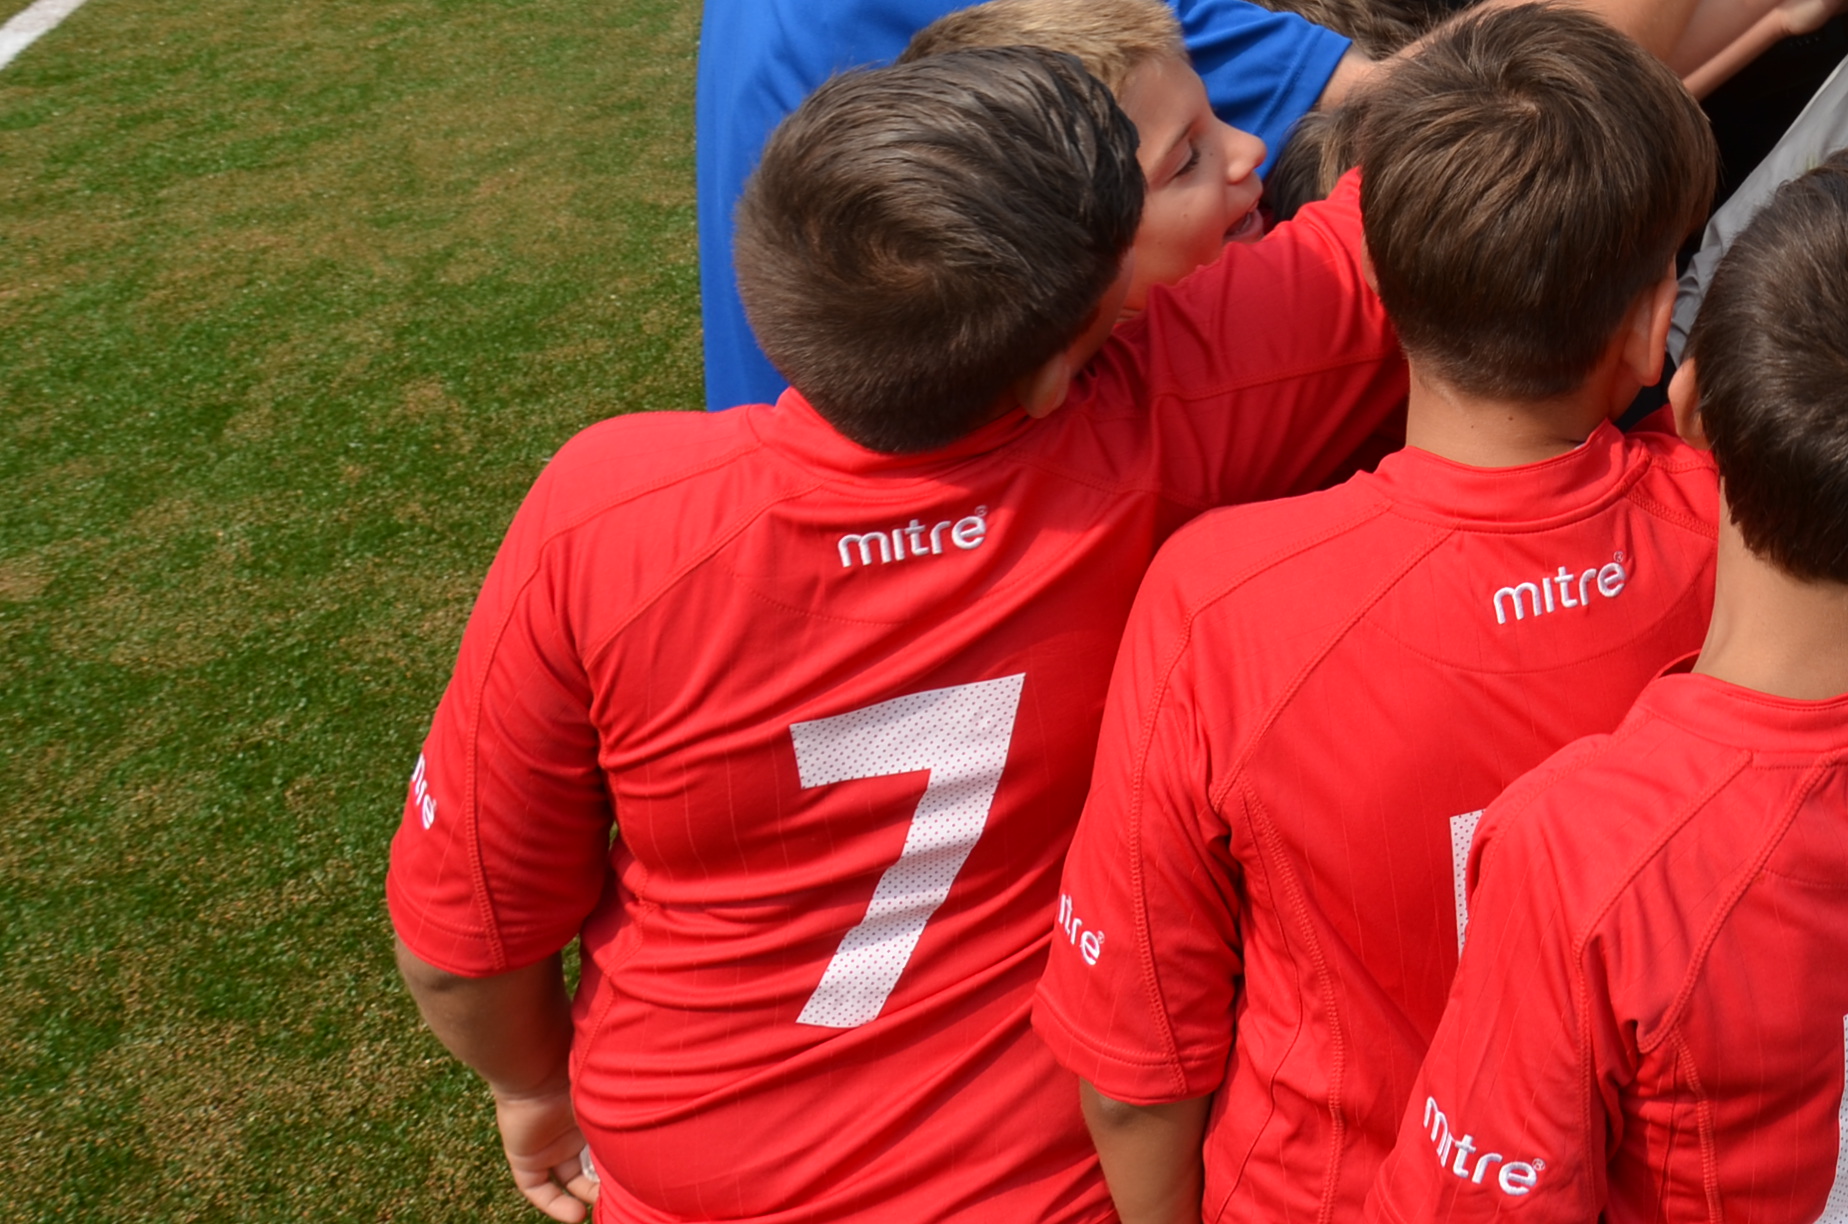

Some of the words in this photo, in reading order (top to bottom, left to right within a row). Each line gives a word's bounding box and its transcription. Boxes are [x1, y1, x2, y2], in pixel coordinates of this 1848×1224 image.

[837, 511, 988, 568] mitre
[1493, 557, 1627, 625] mitre
[790, 673, 1026, 1028] 7
[1424, 1095, 1539, 1196] mitre
